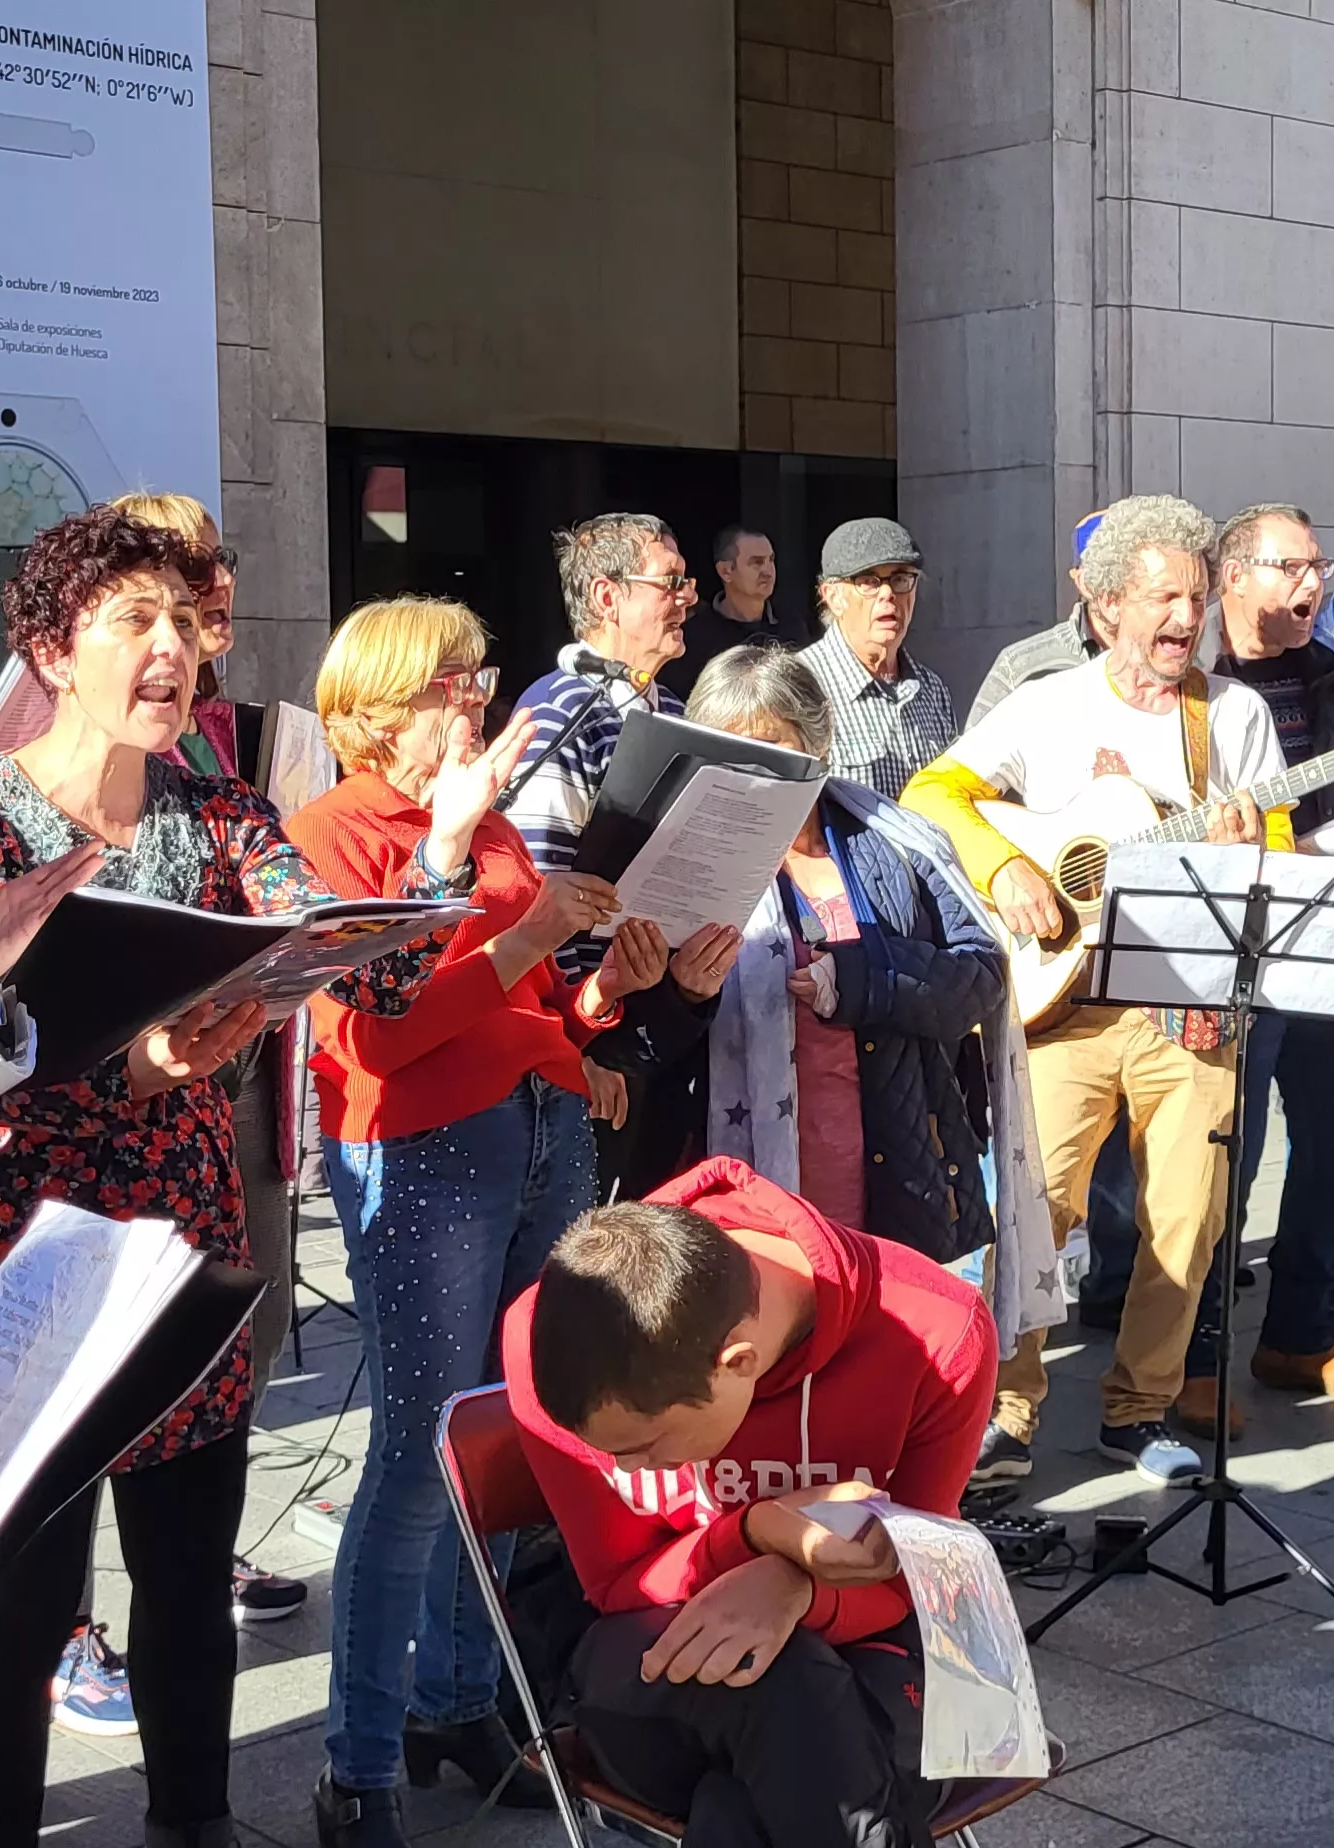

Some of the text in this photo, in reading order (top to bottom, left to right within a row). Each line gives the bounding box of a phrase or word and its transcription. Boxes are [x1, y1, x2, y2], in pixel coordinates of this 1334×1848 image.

[127, 42, 194, 73] HÍDRICA
[5, 276, 49, 293] octubre
[59, 281, 72, 295] 19
[73, 284, 130, 300] noviembre
[132, 288, 160, 303] 2023
[21, 319, 36, 333] de
[37, 323, 103, 339] exposiciones
[55, 342, 69, 357] de
[70, 344, 109, 360] Huesca
